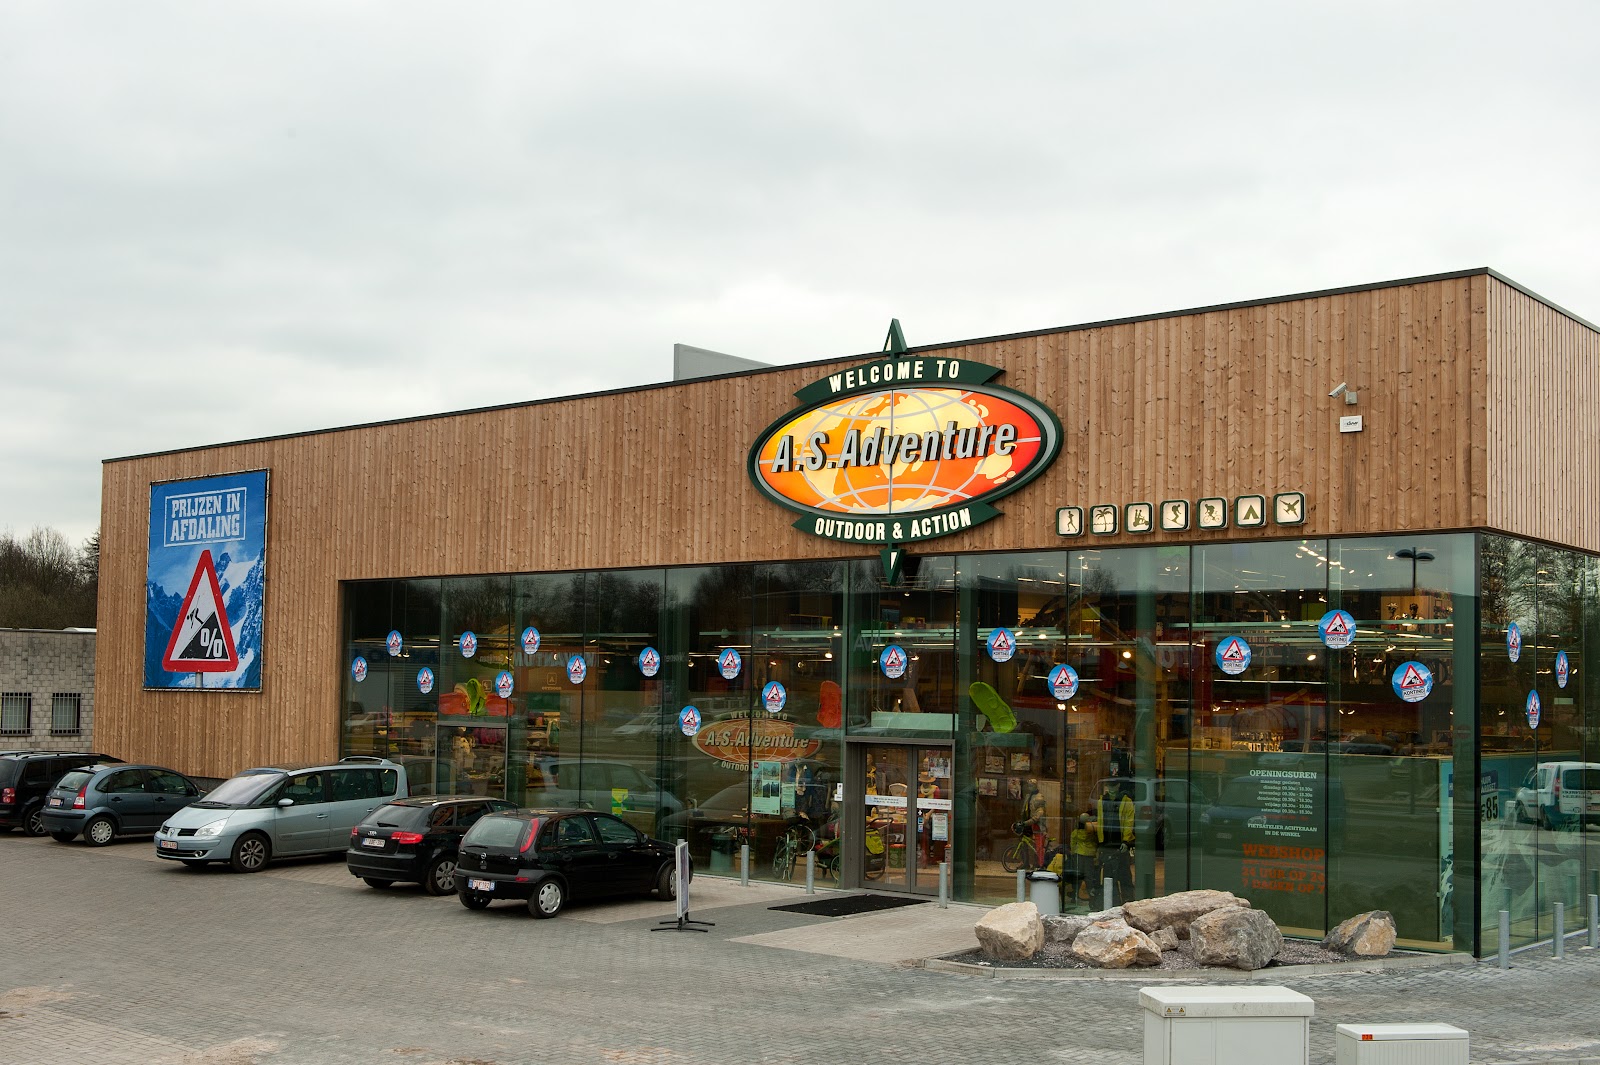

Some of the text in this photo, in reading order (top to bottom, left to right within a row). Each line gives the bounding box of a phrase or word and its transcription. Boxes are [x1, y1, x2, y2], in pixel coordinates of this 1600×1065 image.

[829, 360, 960, 393] WELCOME TO
[771, 421, 1018, 473] A.S.Adventure
[171, 492, 241, 518] PRIJZEN IN
[170, 513, 240, 542] AFDALING
[815, 507, 972, 541] OUTDOOR & ACTION
[1403, 688, 1425, 696] KORTING
[778, 712, 788, 721] TO
[721, 760, 753, 772] OUTDOO
[1249, 770, 1317, 779] OPENINGSUREN
[1242, 843, 1325, 861] WEBSHOP
[1260, 867, 1286, 880] UUR
[1289, 870, 1307, 881] OP
[1251, 880, 1295, 893] DAGEN
[1298, 883, 1315, 894] OP
